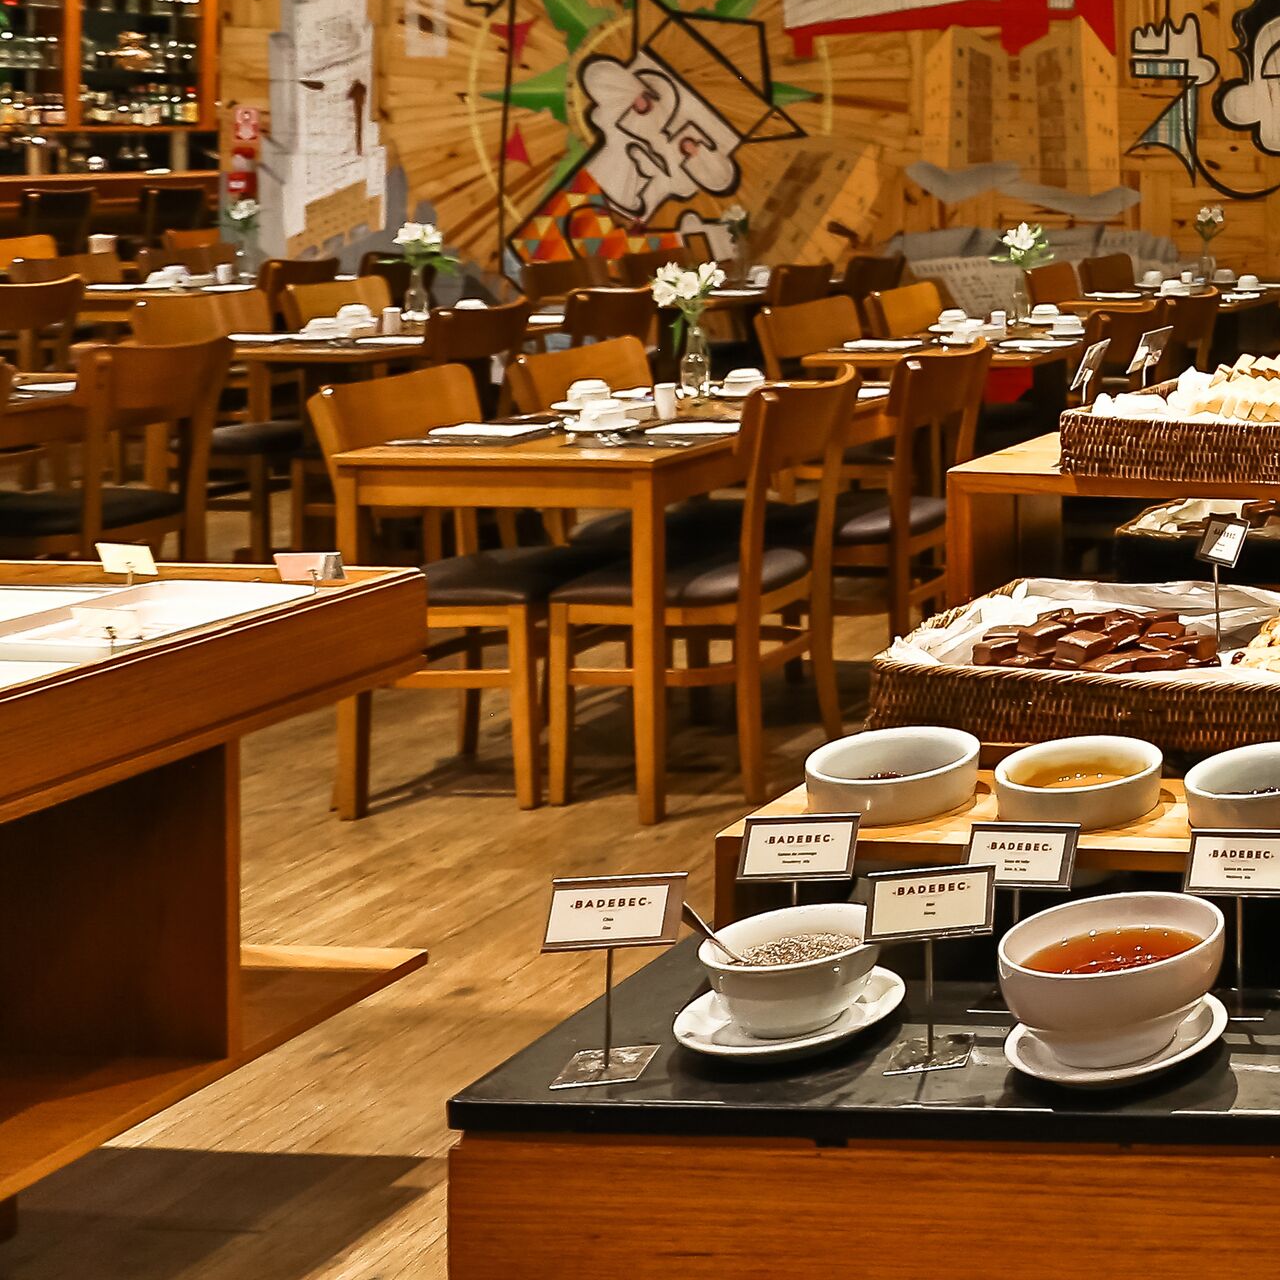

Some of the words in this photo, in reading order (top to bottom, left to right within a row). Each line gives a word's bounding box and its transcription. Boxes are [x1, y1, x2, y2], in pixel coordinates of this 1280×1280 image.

[768, 834, 831, 845] BADEBEC
[990, 841, 1050, 852] BADEBEC
[1212, 849, 1271, 859] BADEBEC
[897, 881, 967, 896] BADEBEC
[575, 896, 648, 910] BADEBEC
